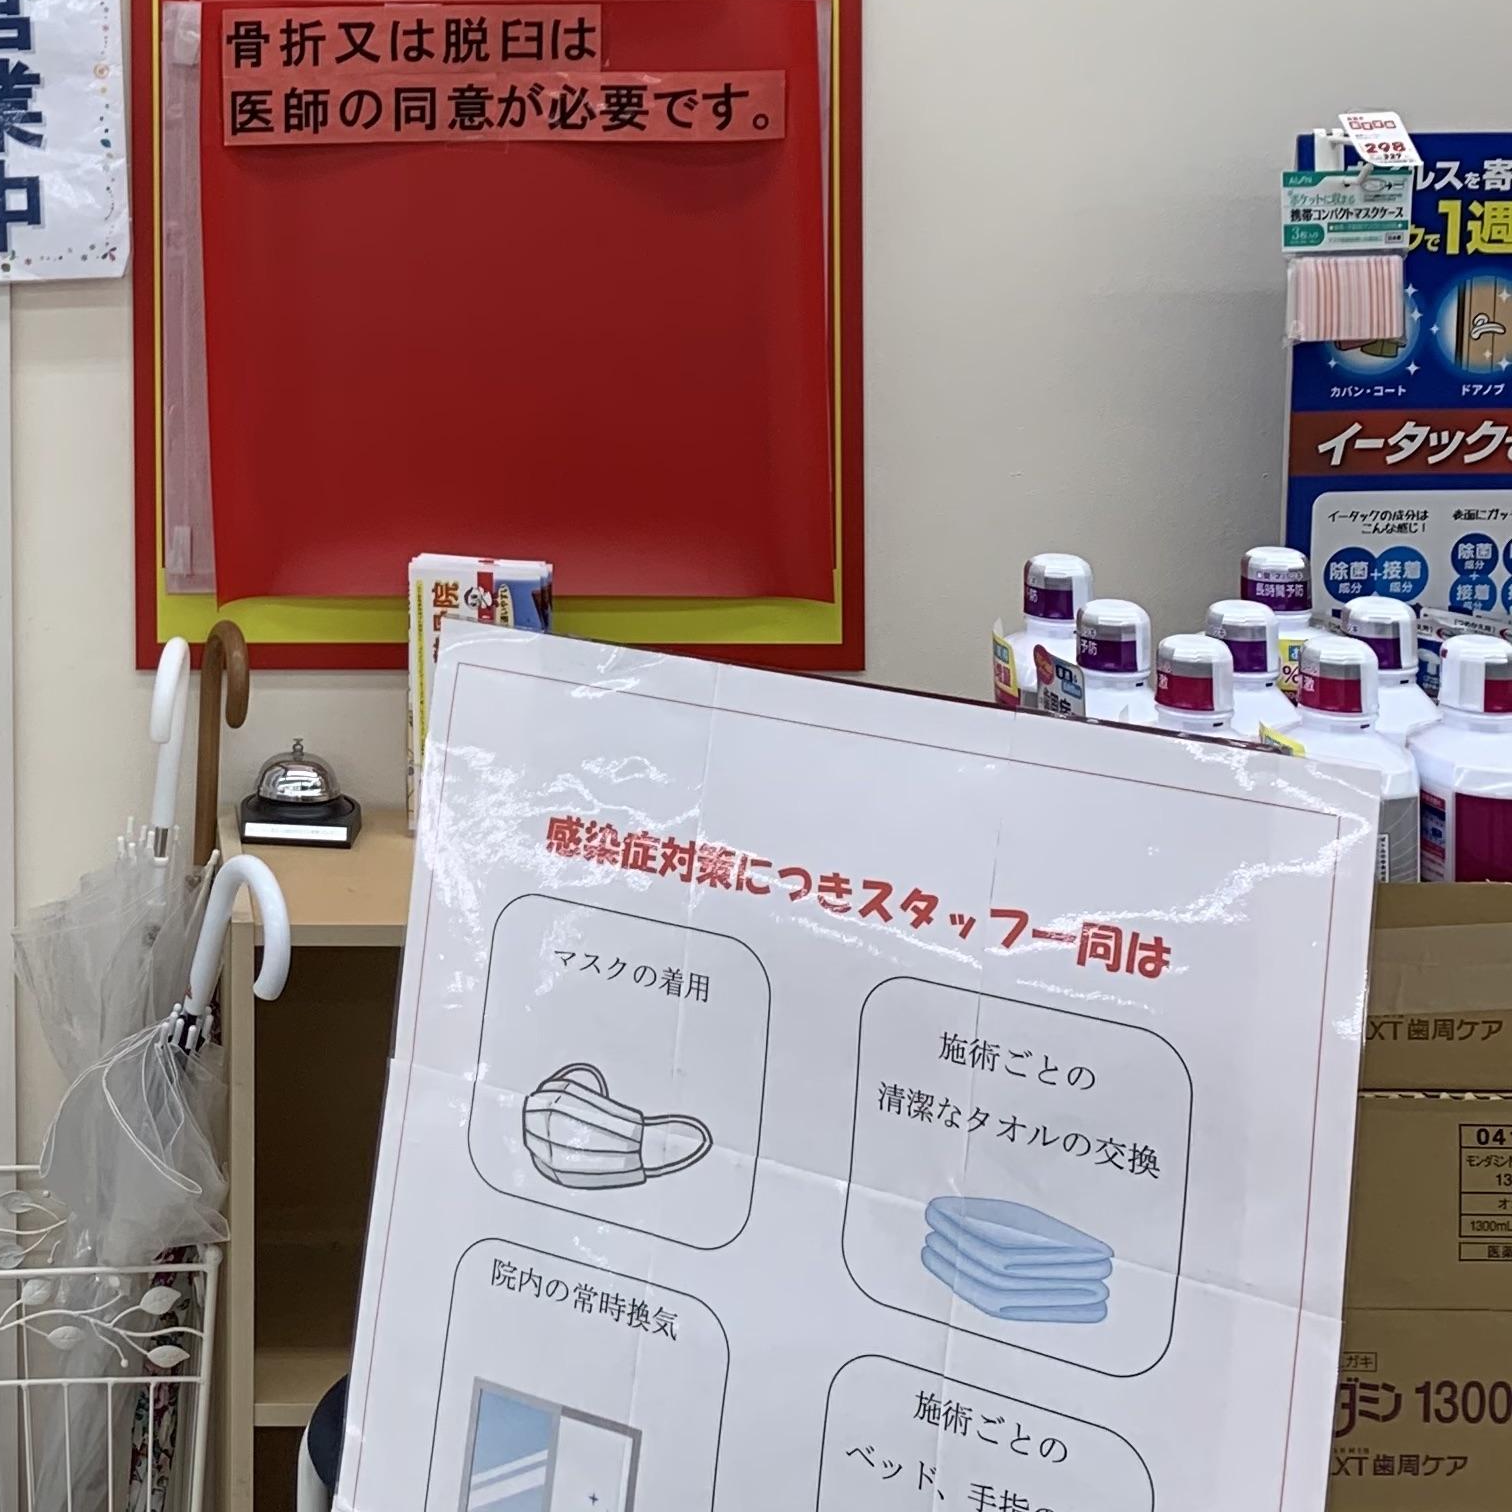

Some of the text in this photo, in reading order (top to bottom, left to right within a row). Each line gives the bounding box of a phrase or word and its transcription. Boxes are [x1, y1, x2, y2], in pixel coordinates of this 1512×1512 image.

[225, 17, 598, 69] 骨折又は脱臼は
[229, 82, 770, 137] 医師の同意が必要です。
[1317, 420, 1512, 467] イータック
[1452, 508, 1512, 521] 表面にガッ
[543, 813, 1172, 980] 感染症対策につきスタッフ一同は
[552, 944, 712, 1005] マスクの着用
[1366, 1018, 1503, 1041] XT歯周ケア
[938, 1030, 1097, 1092] 施術ごとの
[876, 1080, 1162, 1182] 清潔なタオルの交換
[489, 1256, 679, 1344] 院内の常時換気
[1343, 1355, 1374, 1369] ガキ
[913, 1390, 1068, 1464] 施術ごとの
[845, 1444, 1055, 1512] ベッド、手指
[1332, 1454, 1469, 1477] XT歯周ケア
